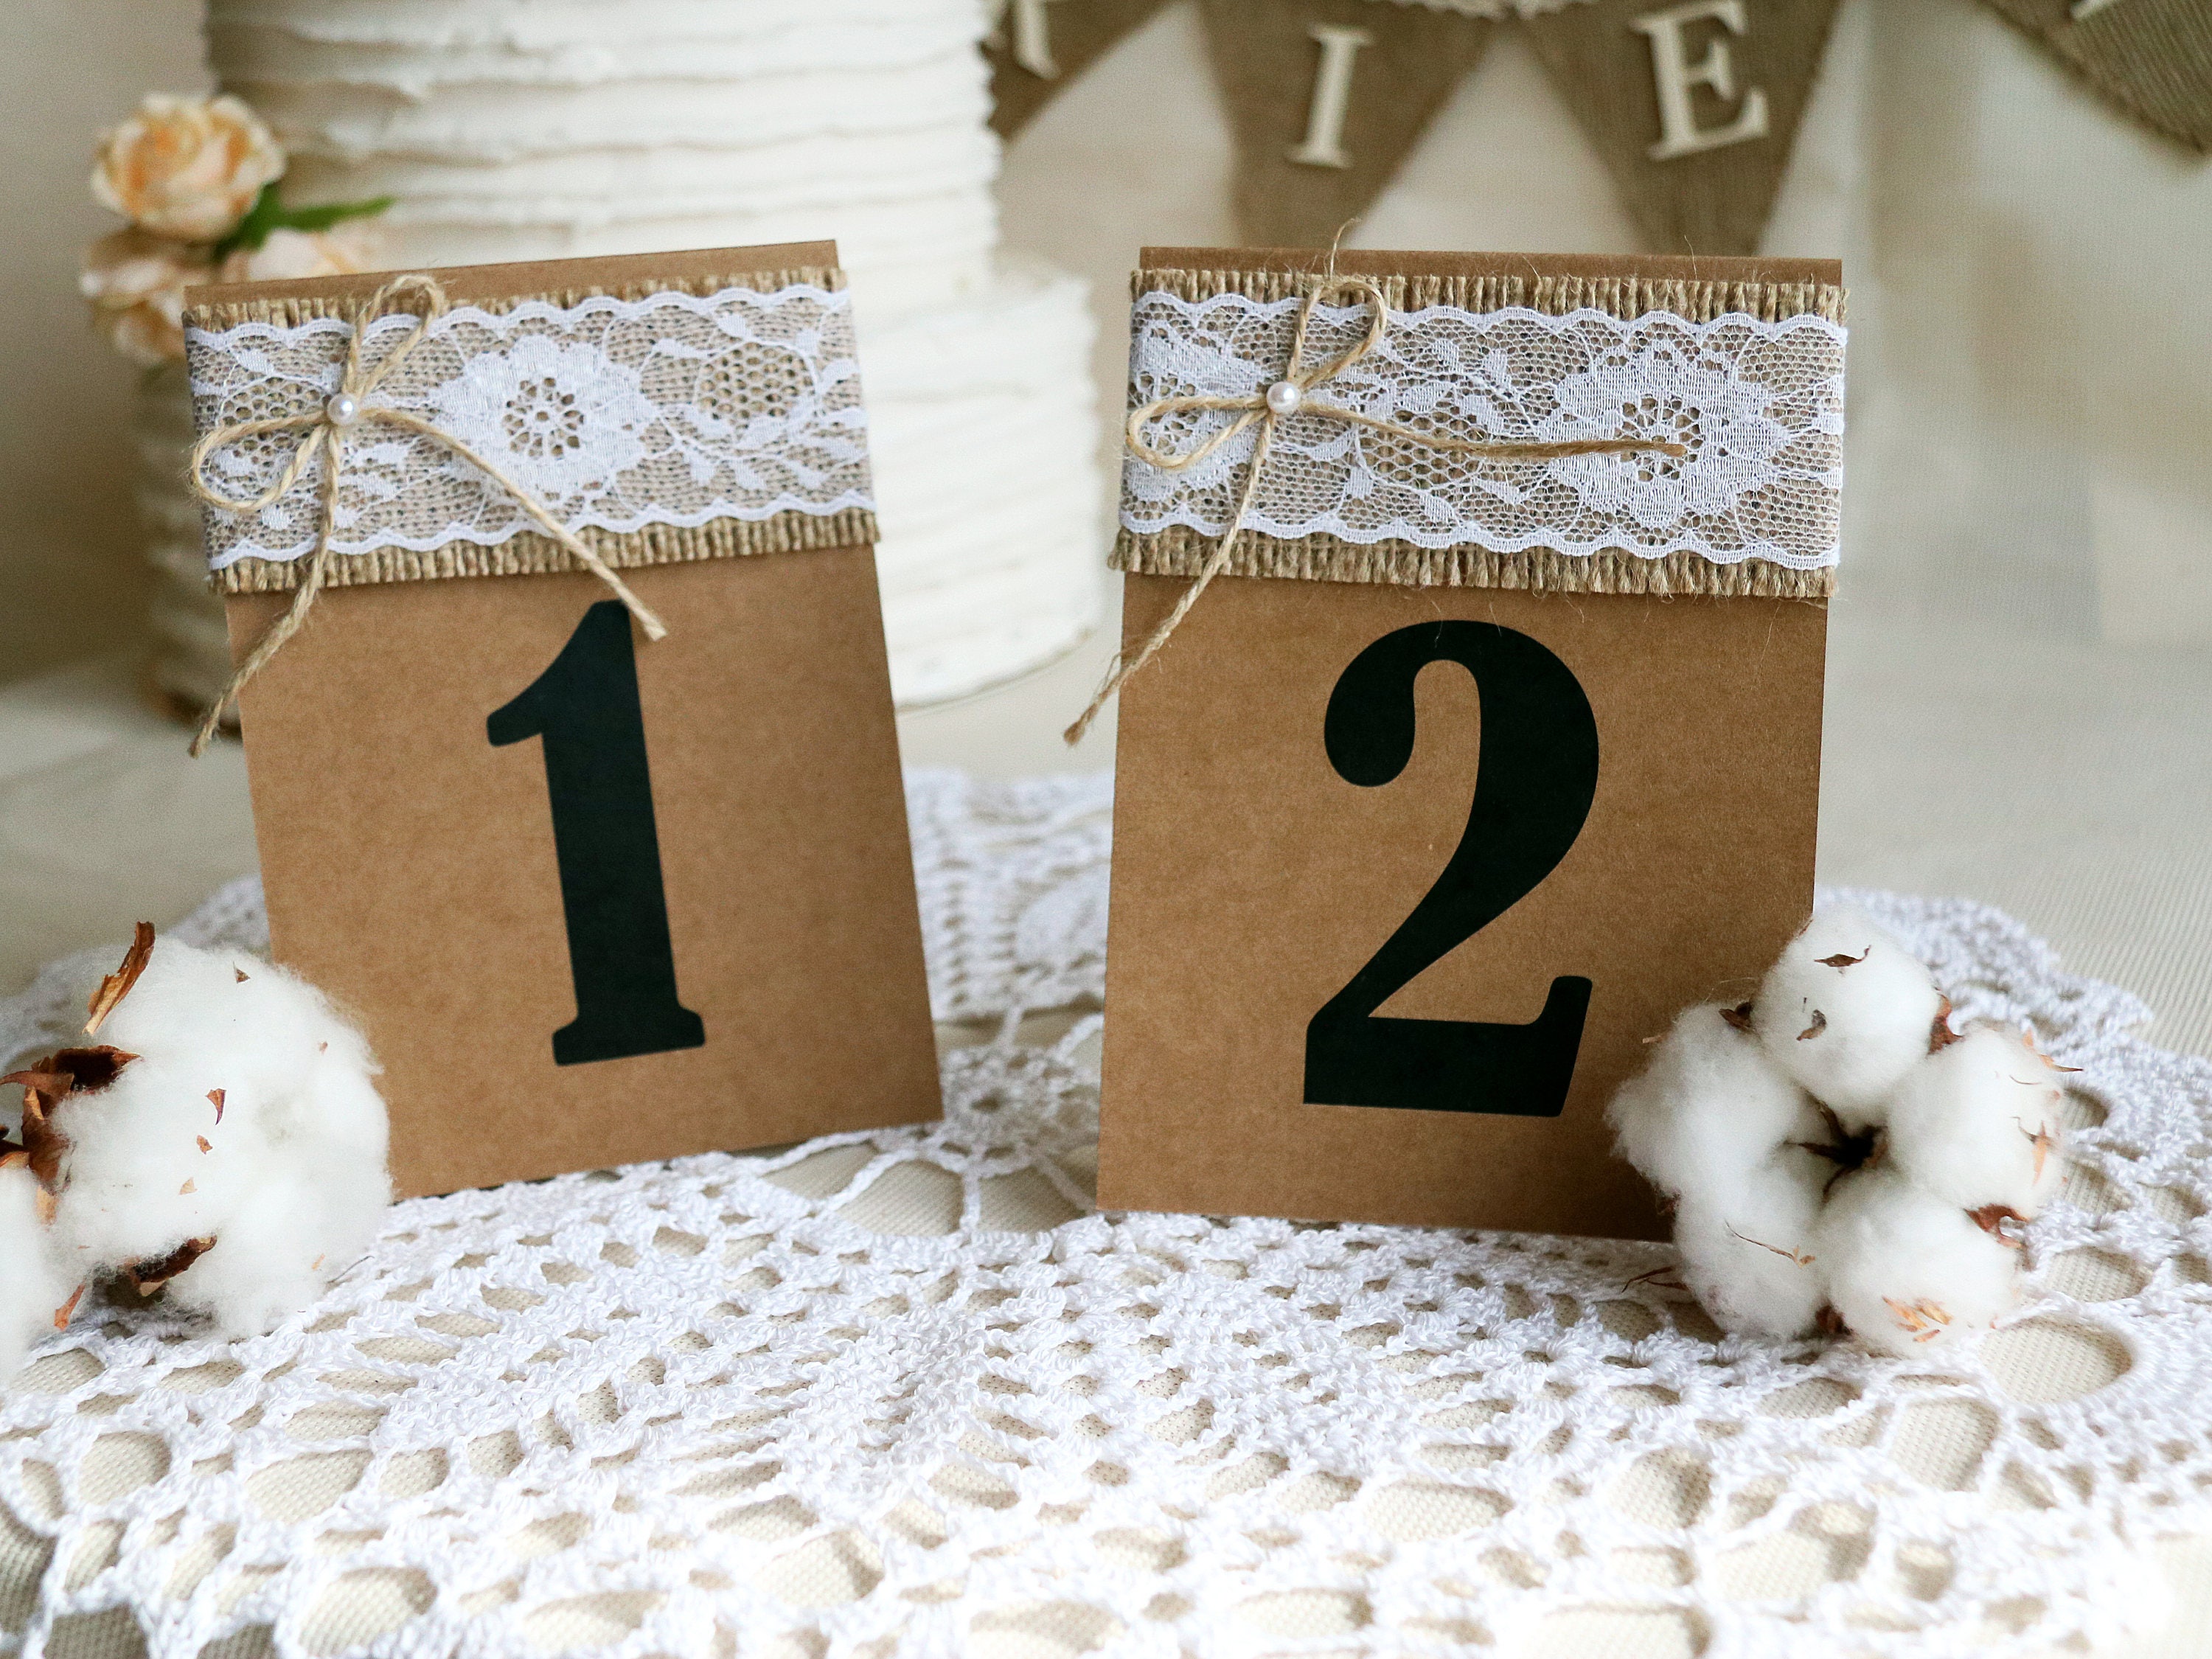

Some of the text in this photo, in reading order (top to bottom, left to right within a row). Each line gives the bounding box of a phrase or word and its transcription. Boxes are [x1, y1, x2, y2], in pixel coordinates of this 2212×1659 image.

[1630, 0, 1769, 161] E
[487, 599, 706, 1067] 1
[1303, 619, 1599, 1118] 2
